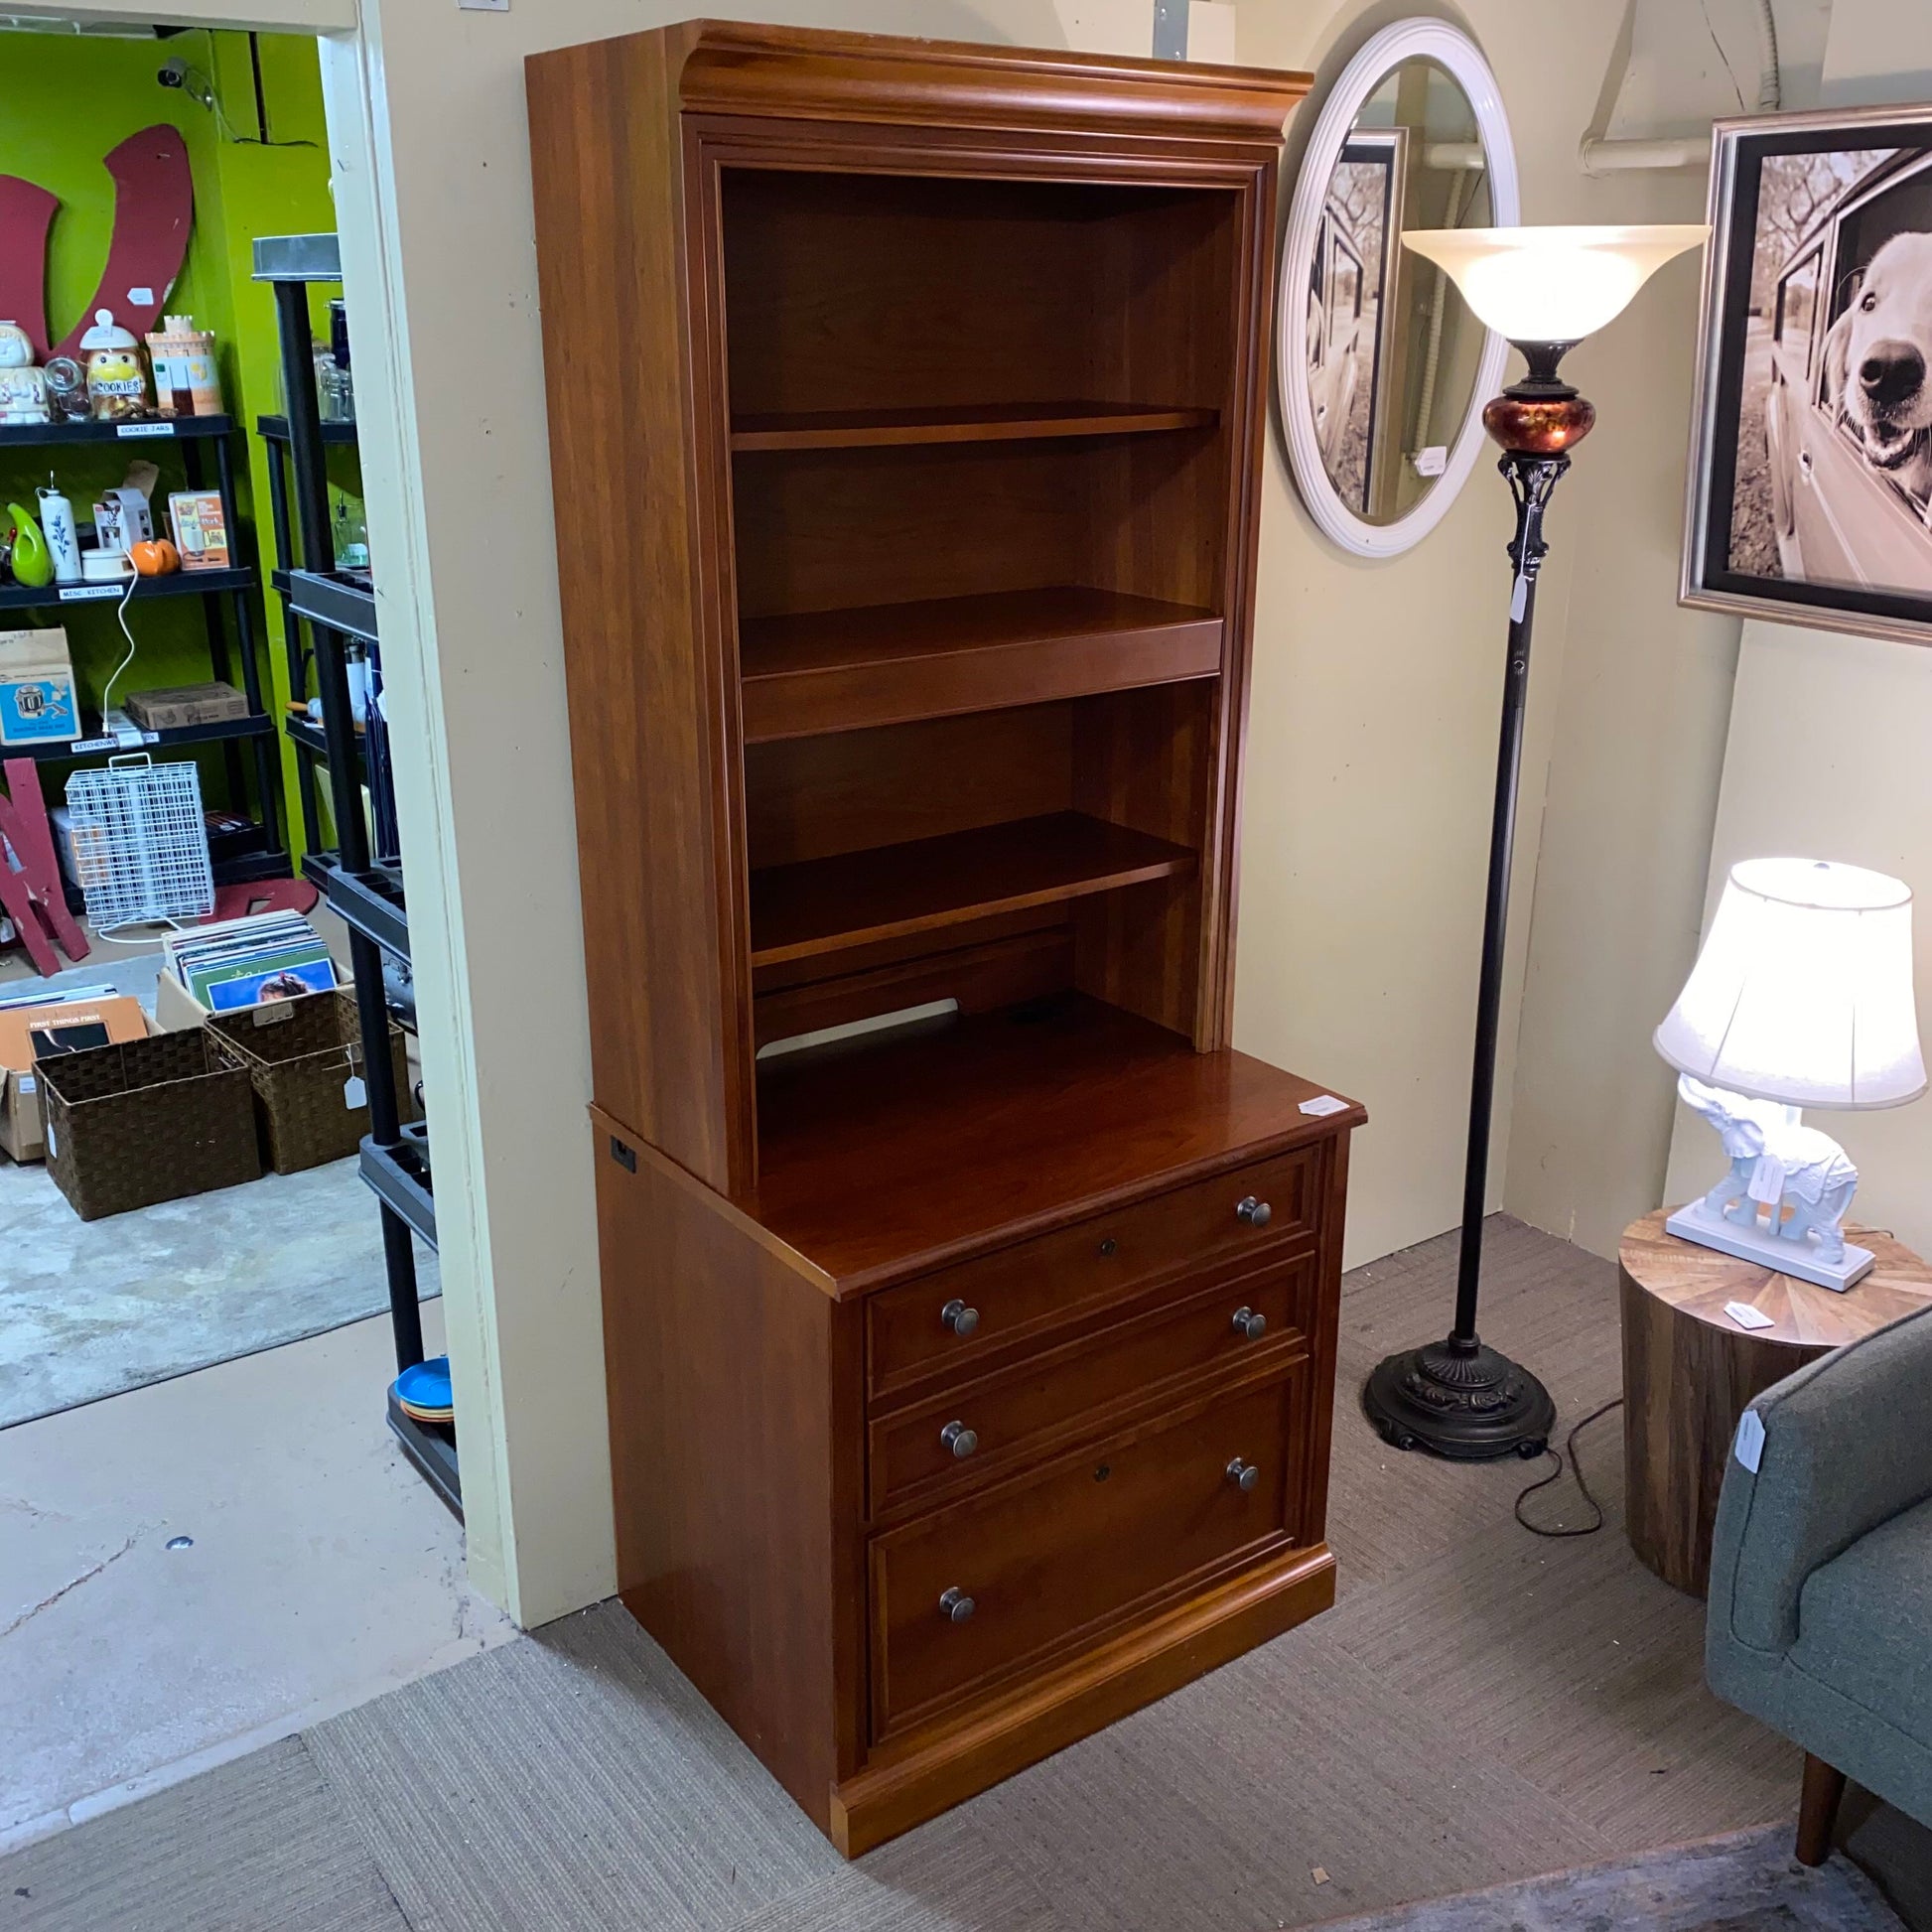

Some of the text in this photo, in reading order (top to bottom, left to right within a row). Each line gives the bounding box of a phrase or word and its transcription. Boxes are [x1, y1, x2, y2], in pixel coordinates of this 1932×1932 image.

[97, 380, 139, 393] COOKIES
[121, 425, 148, 434] COOKIE
[87, 587, 120, 596] KITCHEN
[52, 1017, 79, 1026] THINGS
